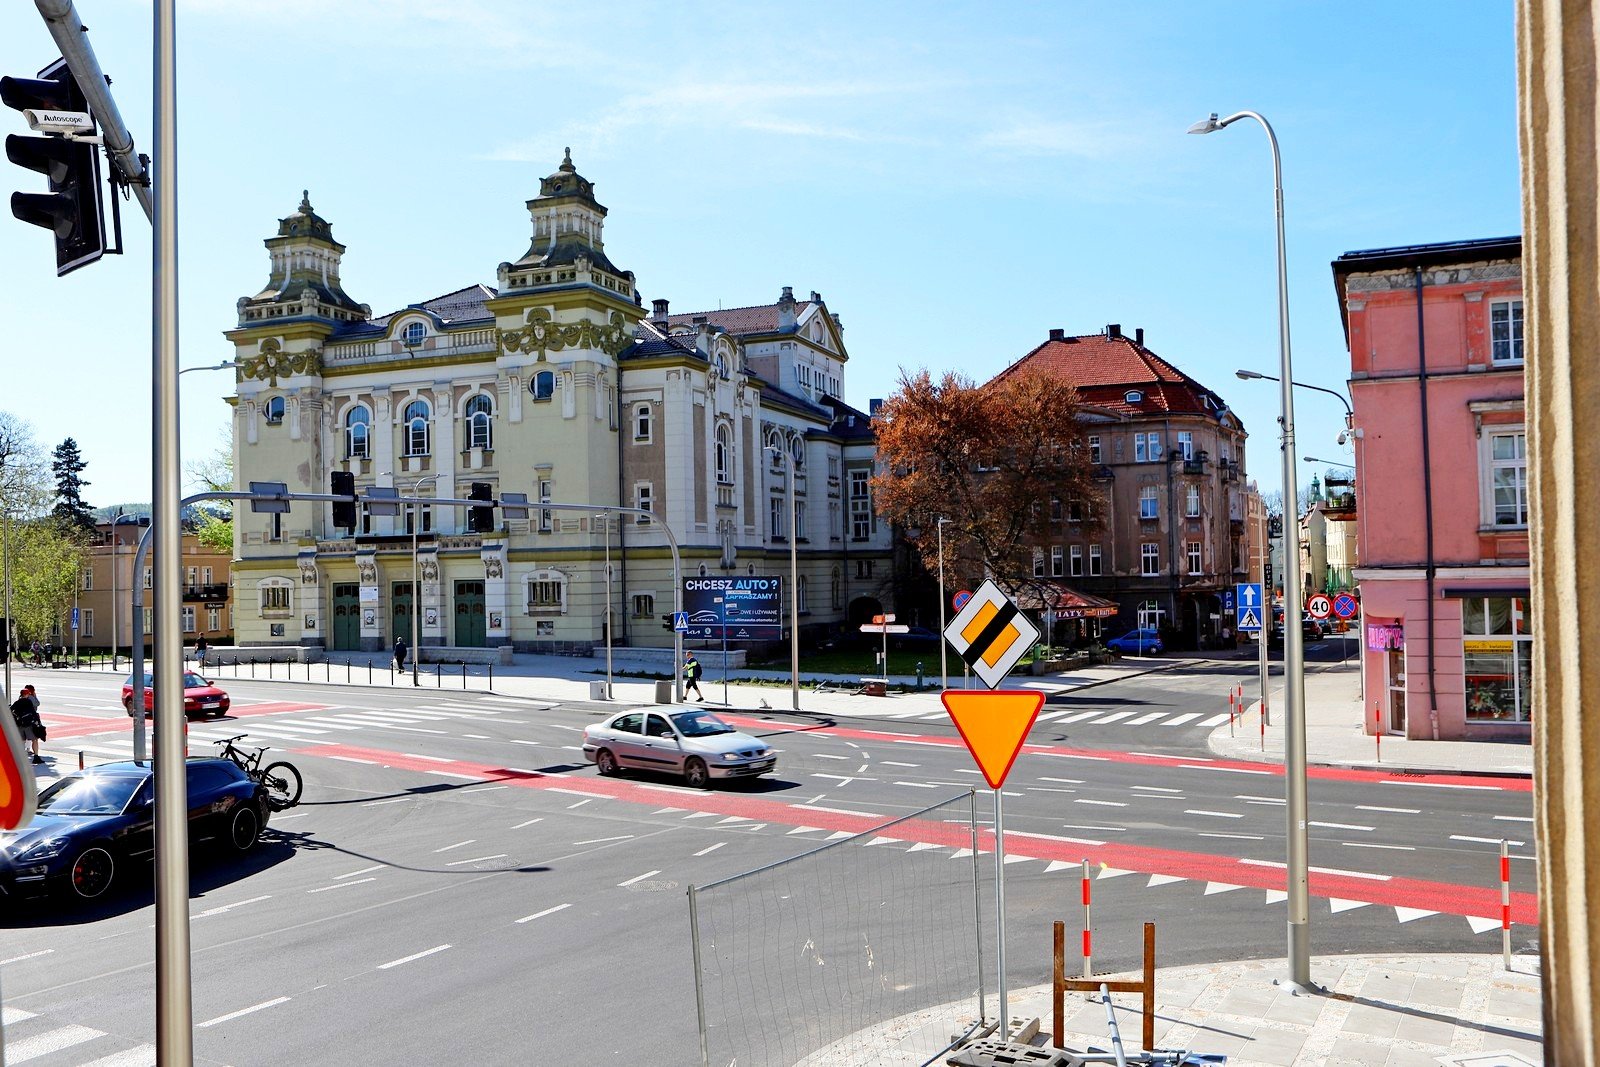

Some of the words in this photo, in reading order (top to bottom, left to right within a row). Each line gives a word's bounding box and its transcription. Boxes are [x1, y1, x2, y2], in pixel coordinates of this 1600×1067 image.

[44, 114, 82, 123] Autoscope
[686, 580, 733, 590] CHCESZ
[735, 580, 768, 590] AUTO
[771, 580, 778, 590] ?
[1312, 601, 1329, 612] 40
